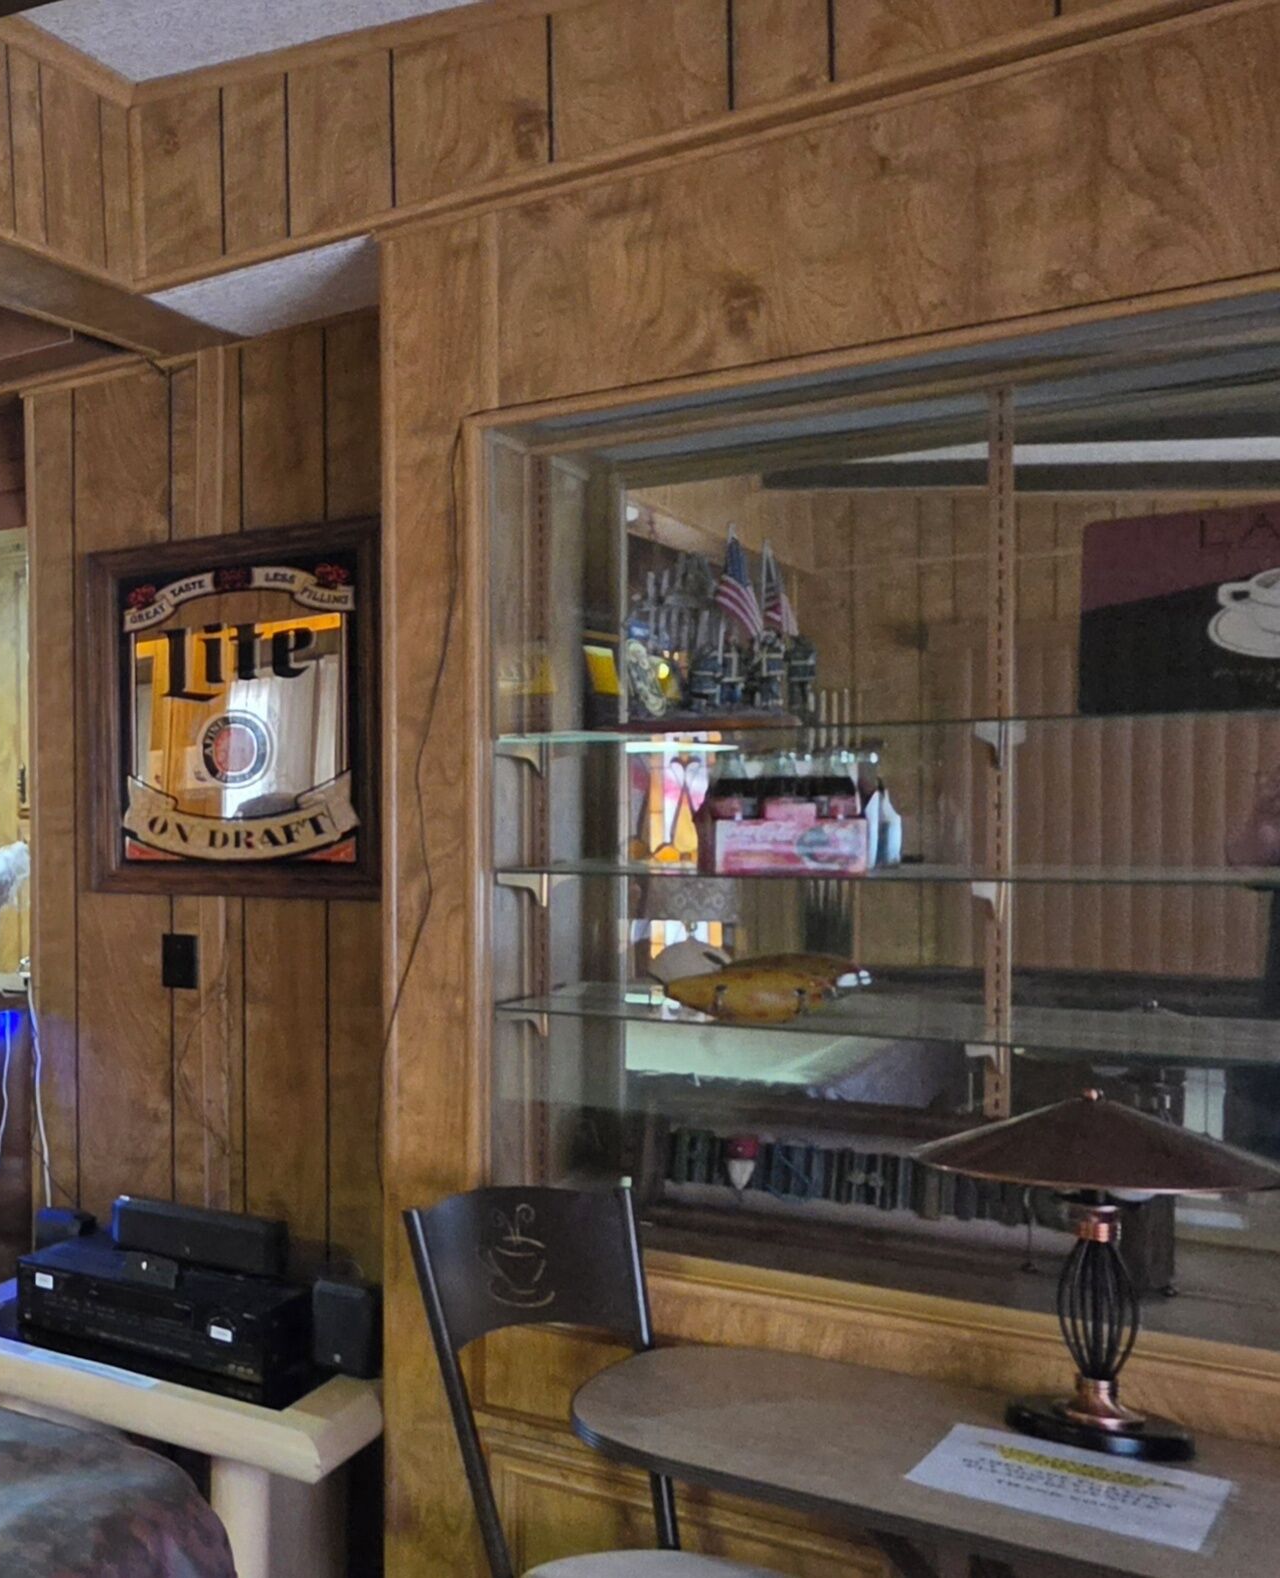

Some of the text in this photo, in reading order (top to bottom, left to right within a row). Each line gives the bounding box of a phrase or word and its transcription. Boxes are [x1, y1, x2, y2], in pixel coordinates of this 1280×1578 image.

[130, 579, 206, 625] GREAT TASTE
[264, 571, 349, 605] LESS FILLING
[161, 623, 317, 701] Lite
[148, 811, 330, 850] ON DRAFT
